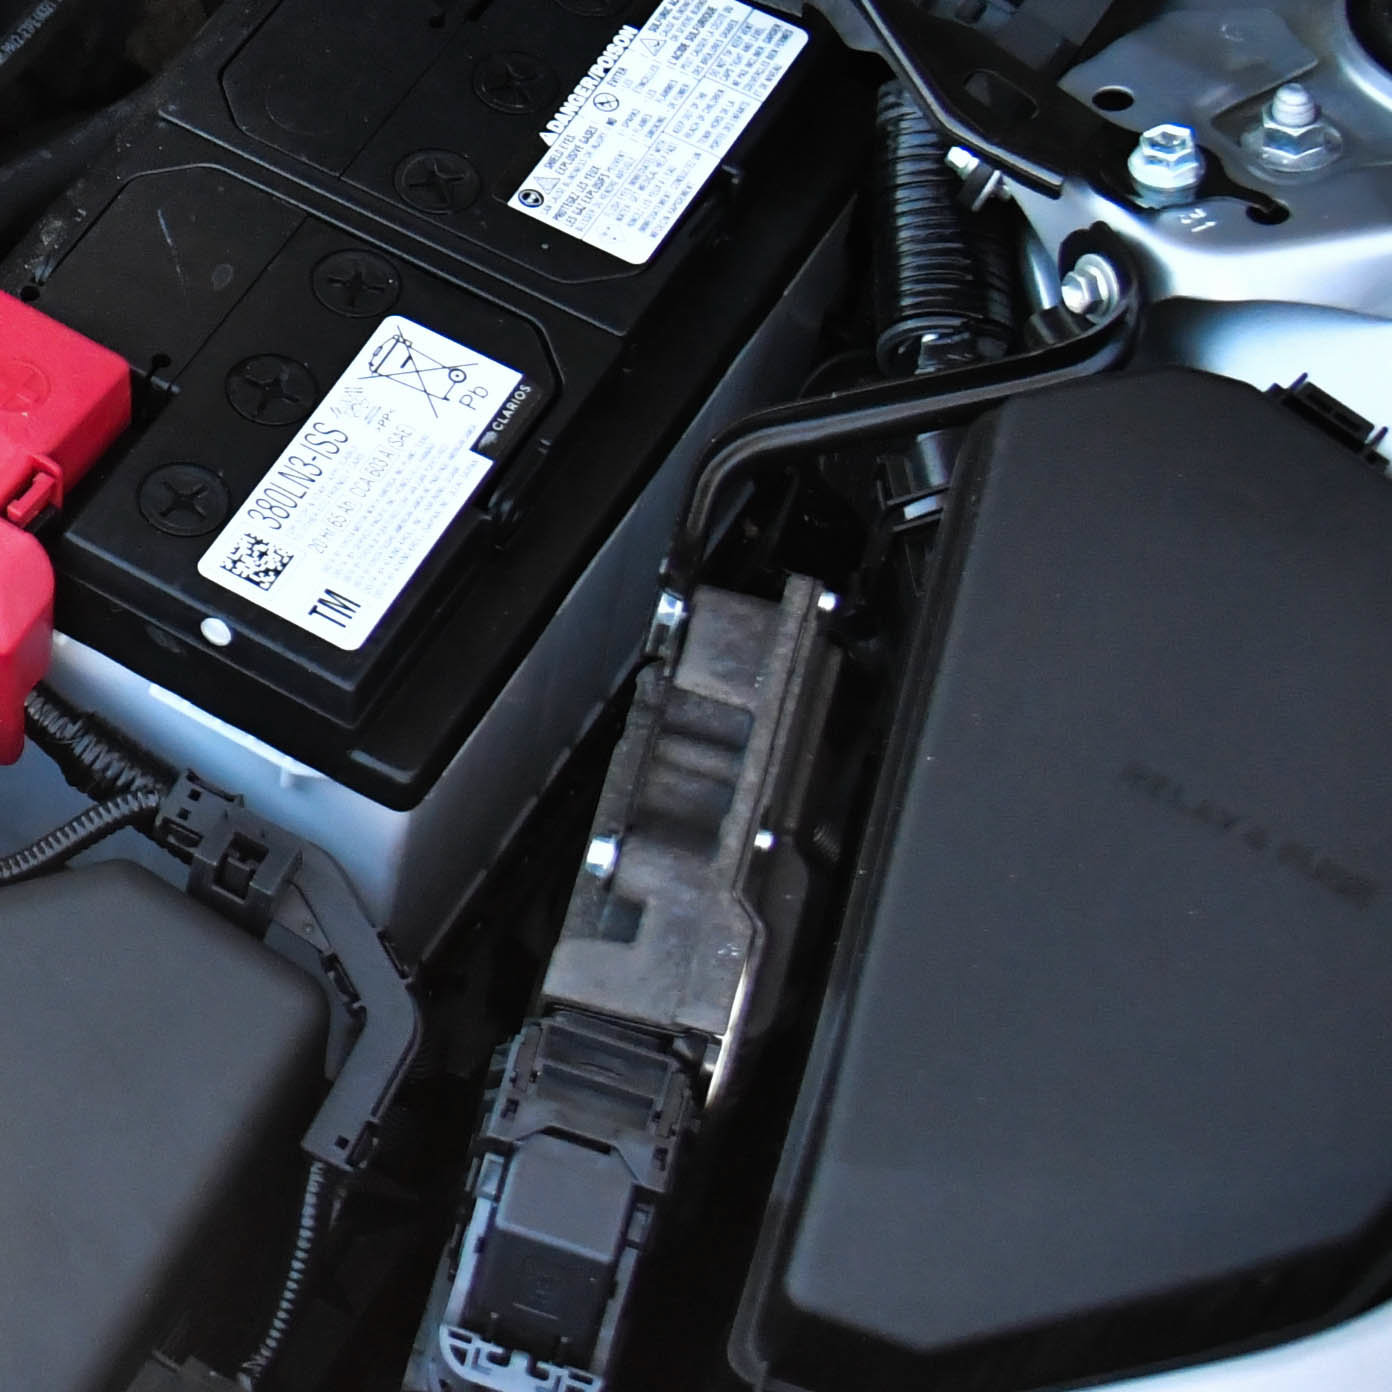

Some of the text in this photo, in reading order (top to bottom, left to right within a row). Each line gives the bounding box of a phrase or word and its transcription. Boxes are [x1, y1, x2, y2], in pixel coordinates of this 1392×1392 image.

[646, 5, 673, 33] SULFURIC
[545, 24, 639, 134] DANGER/POISON
[542, 132, 577, 170] SHIELD EYES
[553, 124, 599, 176] EXPLOSIVE GASES
[457, 381, 491, 411] Pb
[489, 382, 532, 432] CLARIOS
[243, 419, 351, 532] 380LN3-ISS
[305, 536, 330, 554] 20
[324, 510, 349, 529] 65
[347, 473, 377, 499] CCA
[306, 587, 362, 632] TM
